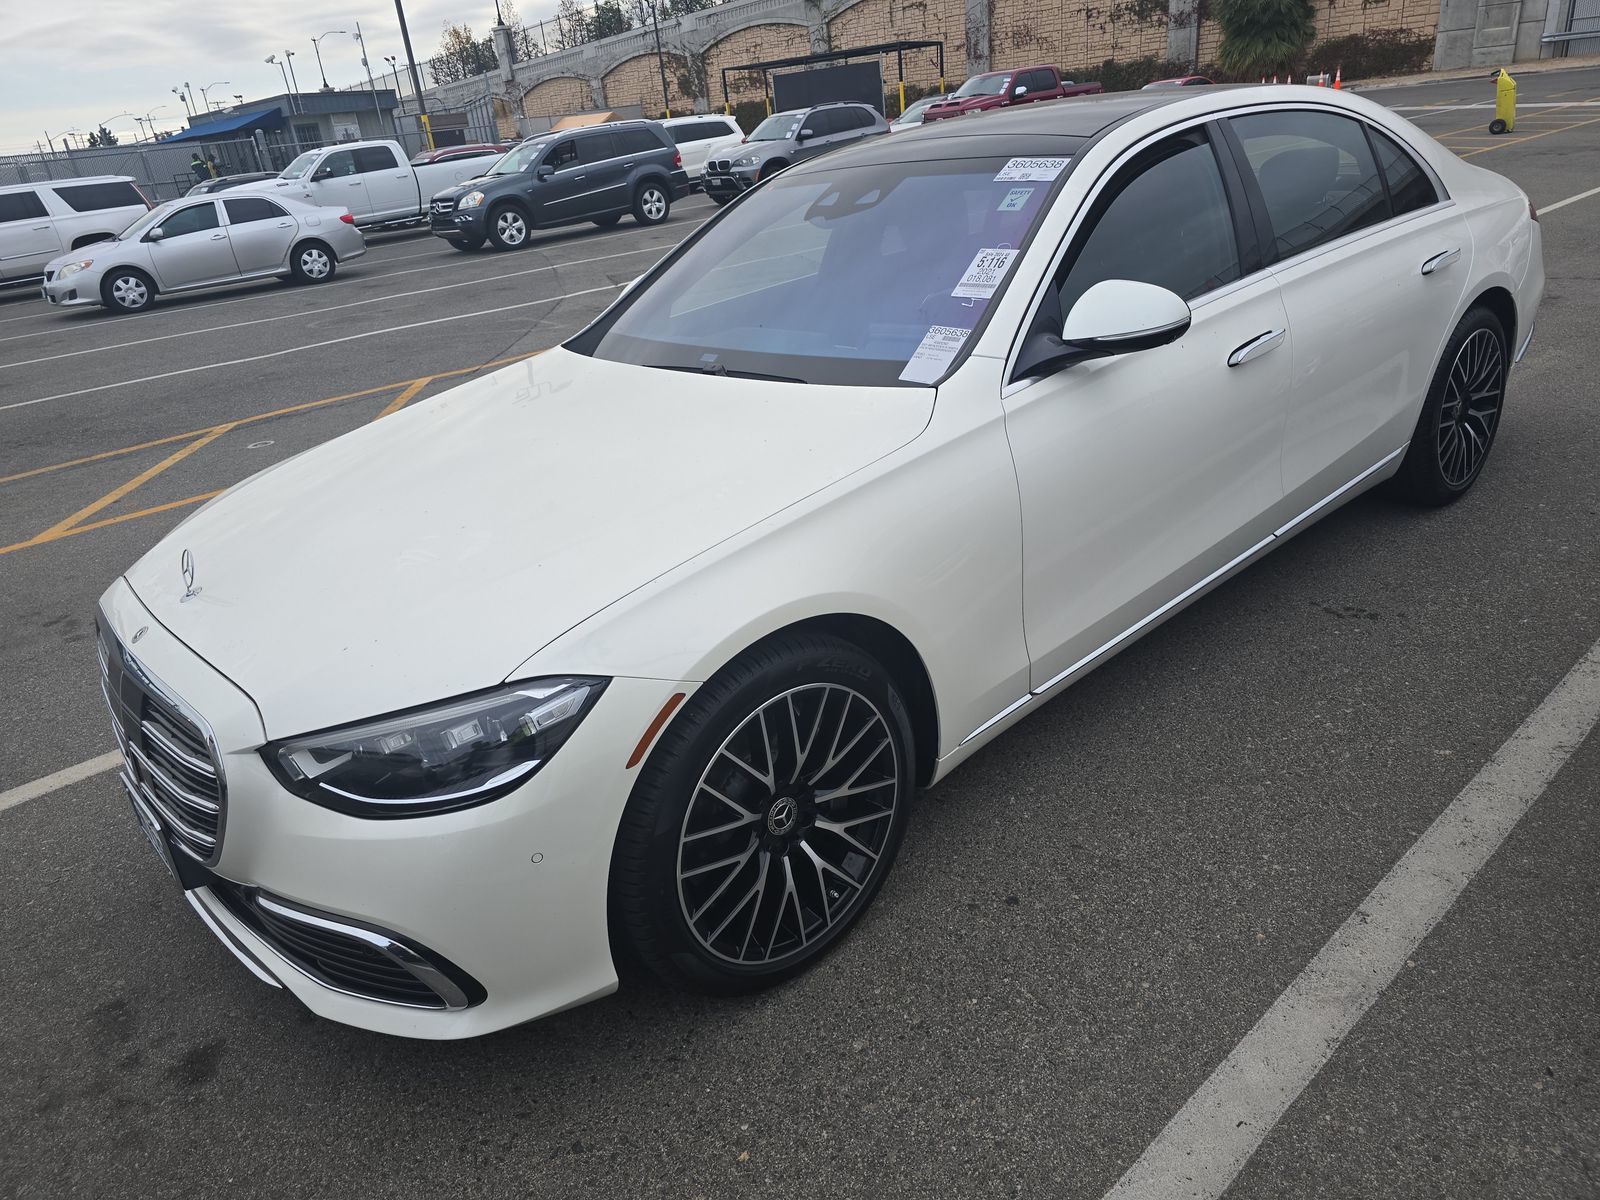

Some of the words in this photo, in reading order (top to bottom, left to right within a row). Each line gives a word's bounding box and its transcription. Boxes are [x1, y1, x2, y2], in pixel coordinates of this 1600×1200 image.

[1007, 160, 1064, 168] 3605638
[977, 256, 1007, 268] 5:116
[928, 326, 969, 338] 3605638
